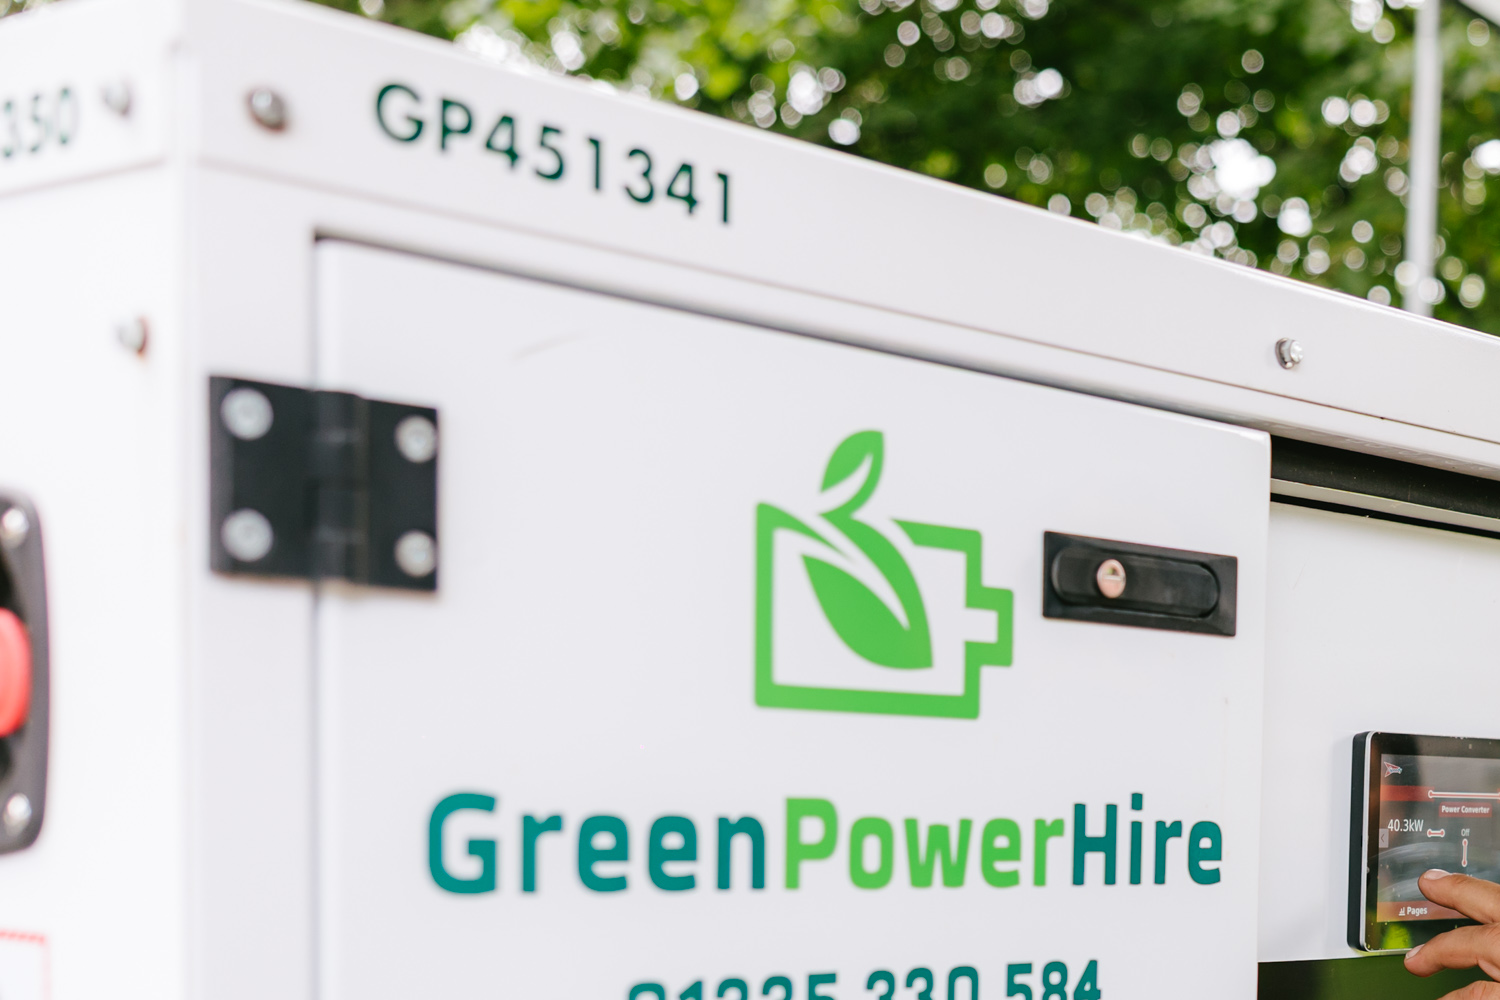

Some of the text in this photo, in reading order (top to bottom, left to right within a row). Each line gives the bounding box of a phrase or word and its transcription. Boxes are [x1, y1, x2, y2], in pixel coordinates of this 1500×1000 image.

[375, 83, 731, 224] GP451341
[1441, 805, 1490, 814] Power Converter
[1387, 819, 1424, 832] 40.3kW
[1461, 828, 1470, 837] Off
[427, 792, 1223, 895] GreenPowerHire
[1406, 907, 1428, 916] Pages
